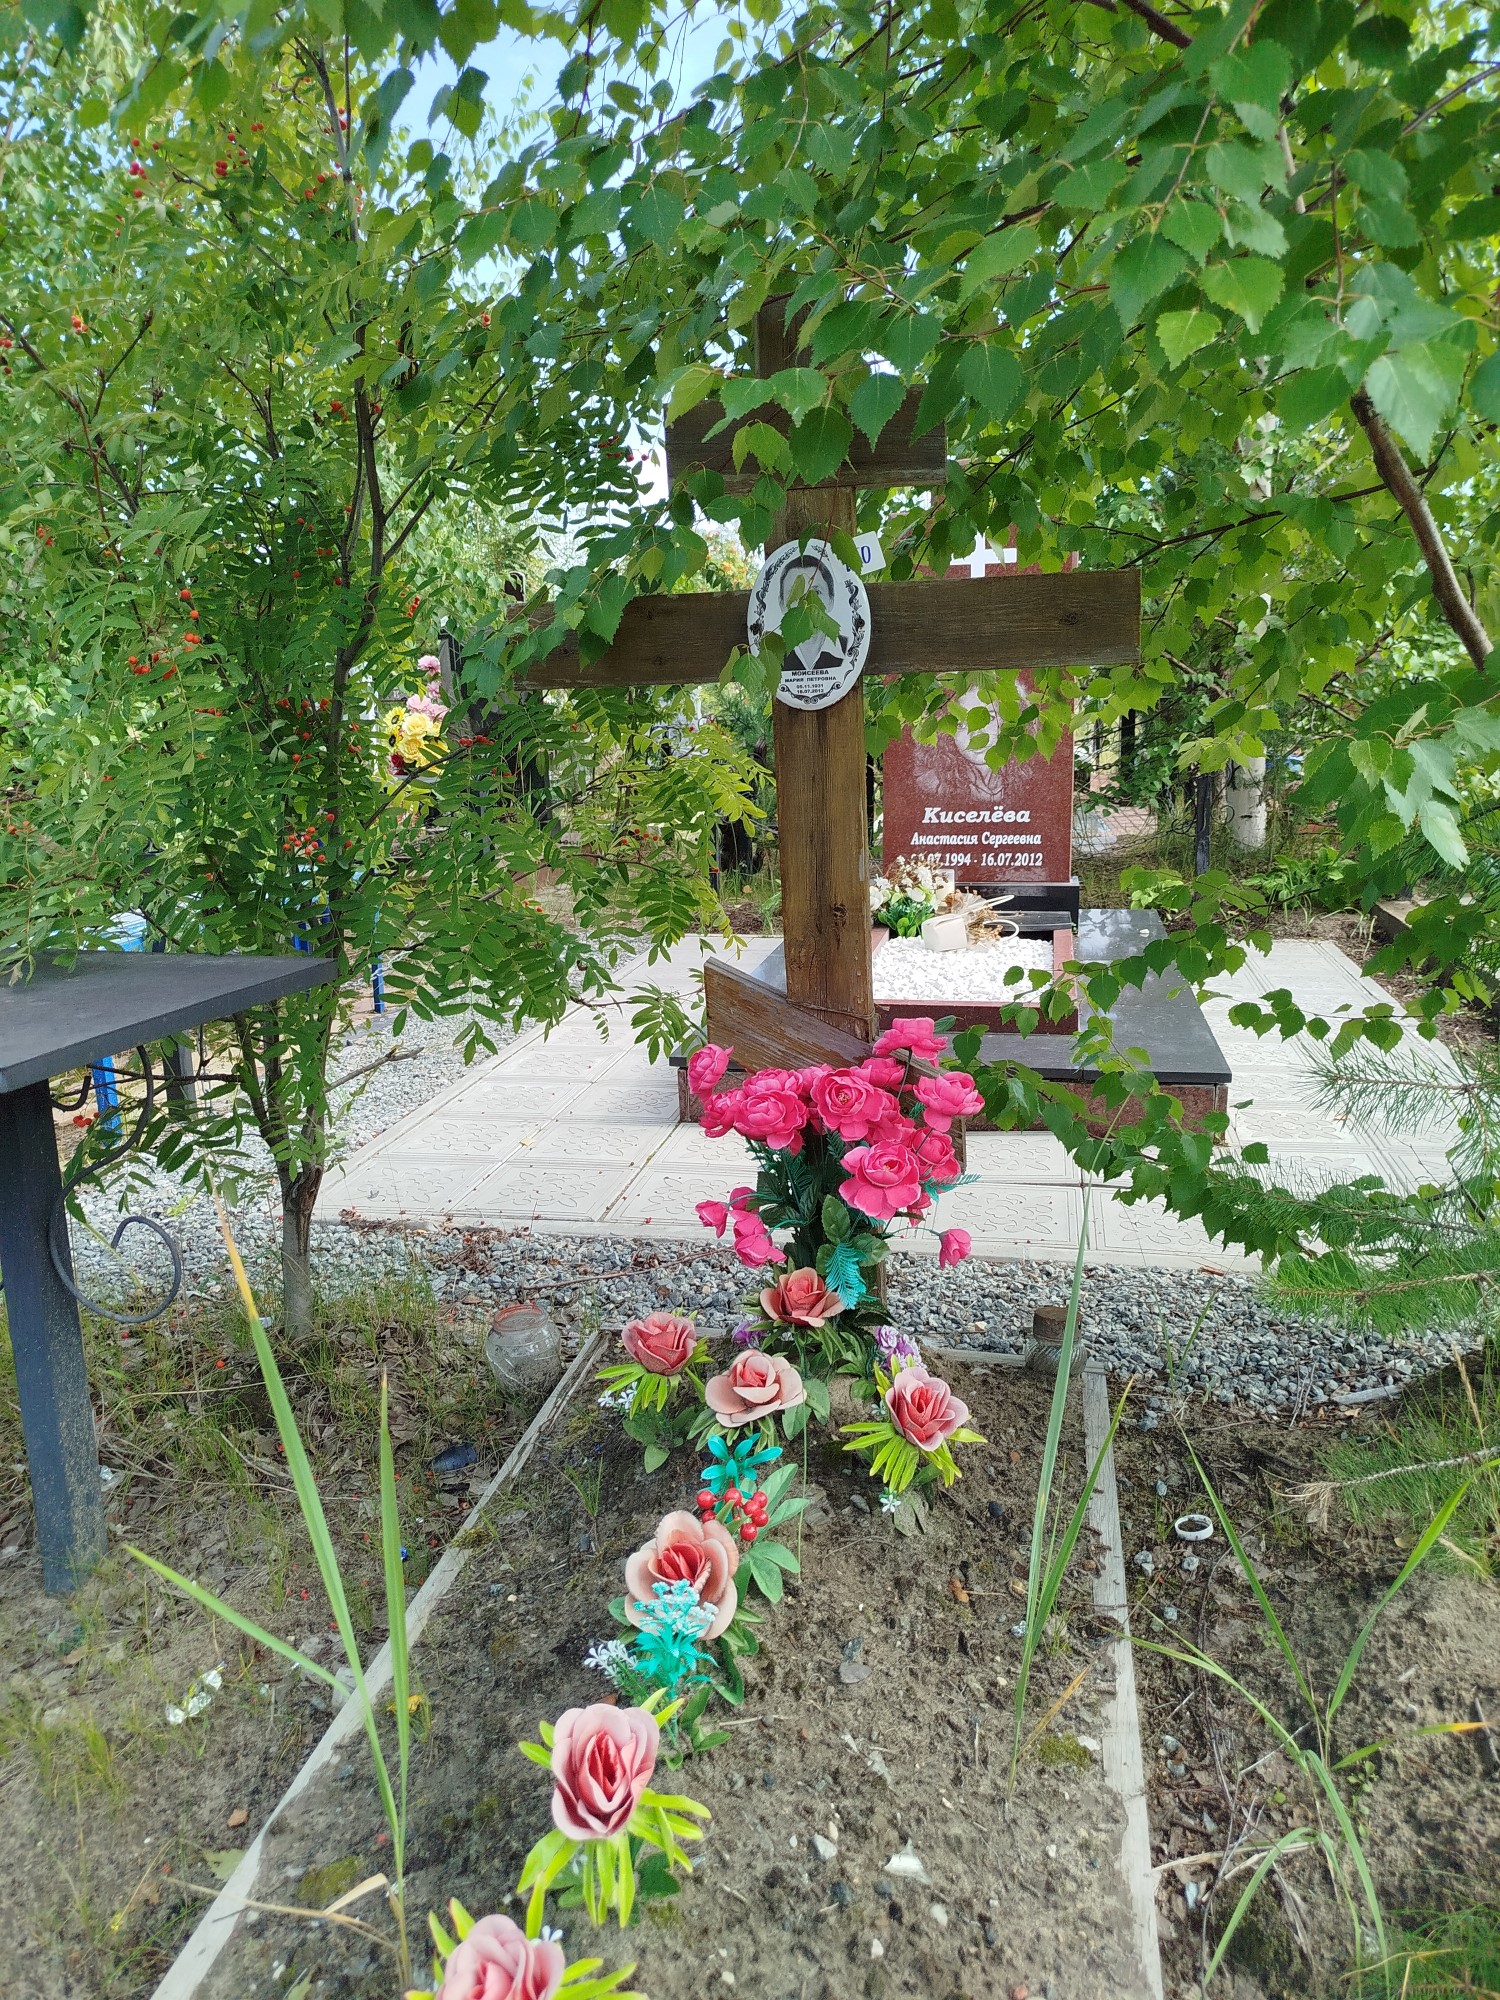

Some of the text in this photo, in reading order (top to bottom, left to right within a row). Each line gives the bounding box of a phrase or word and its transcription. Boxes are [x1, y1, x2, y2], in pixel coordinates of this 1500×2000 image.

[922, 806, 1031, 824] Киселёва
[910, 831, 1042, 848] Анастасия Сергеевна
[910, 852, 972, 867] 07.1994
[980, 852, 1043, 867] 16.07.2012
